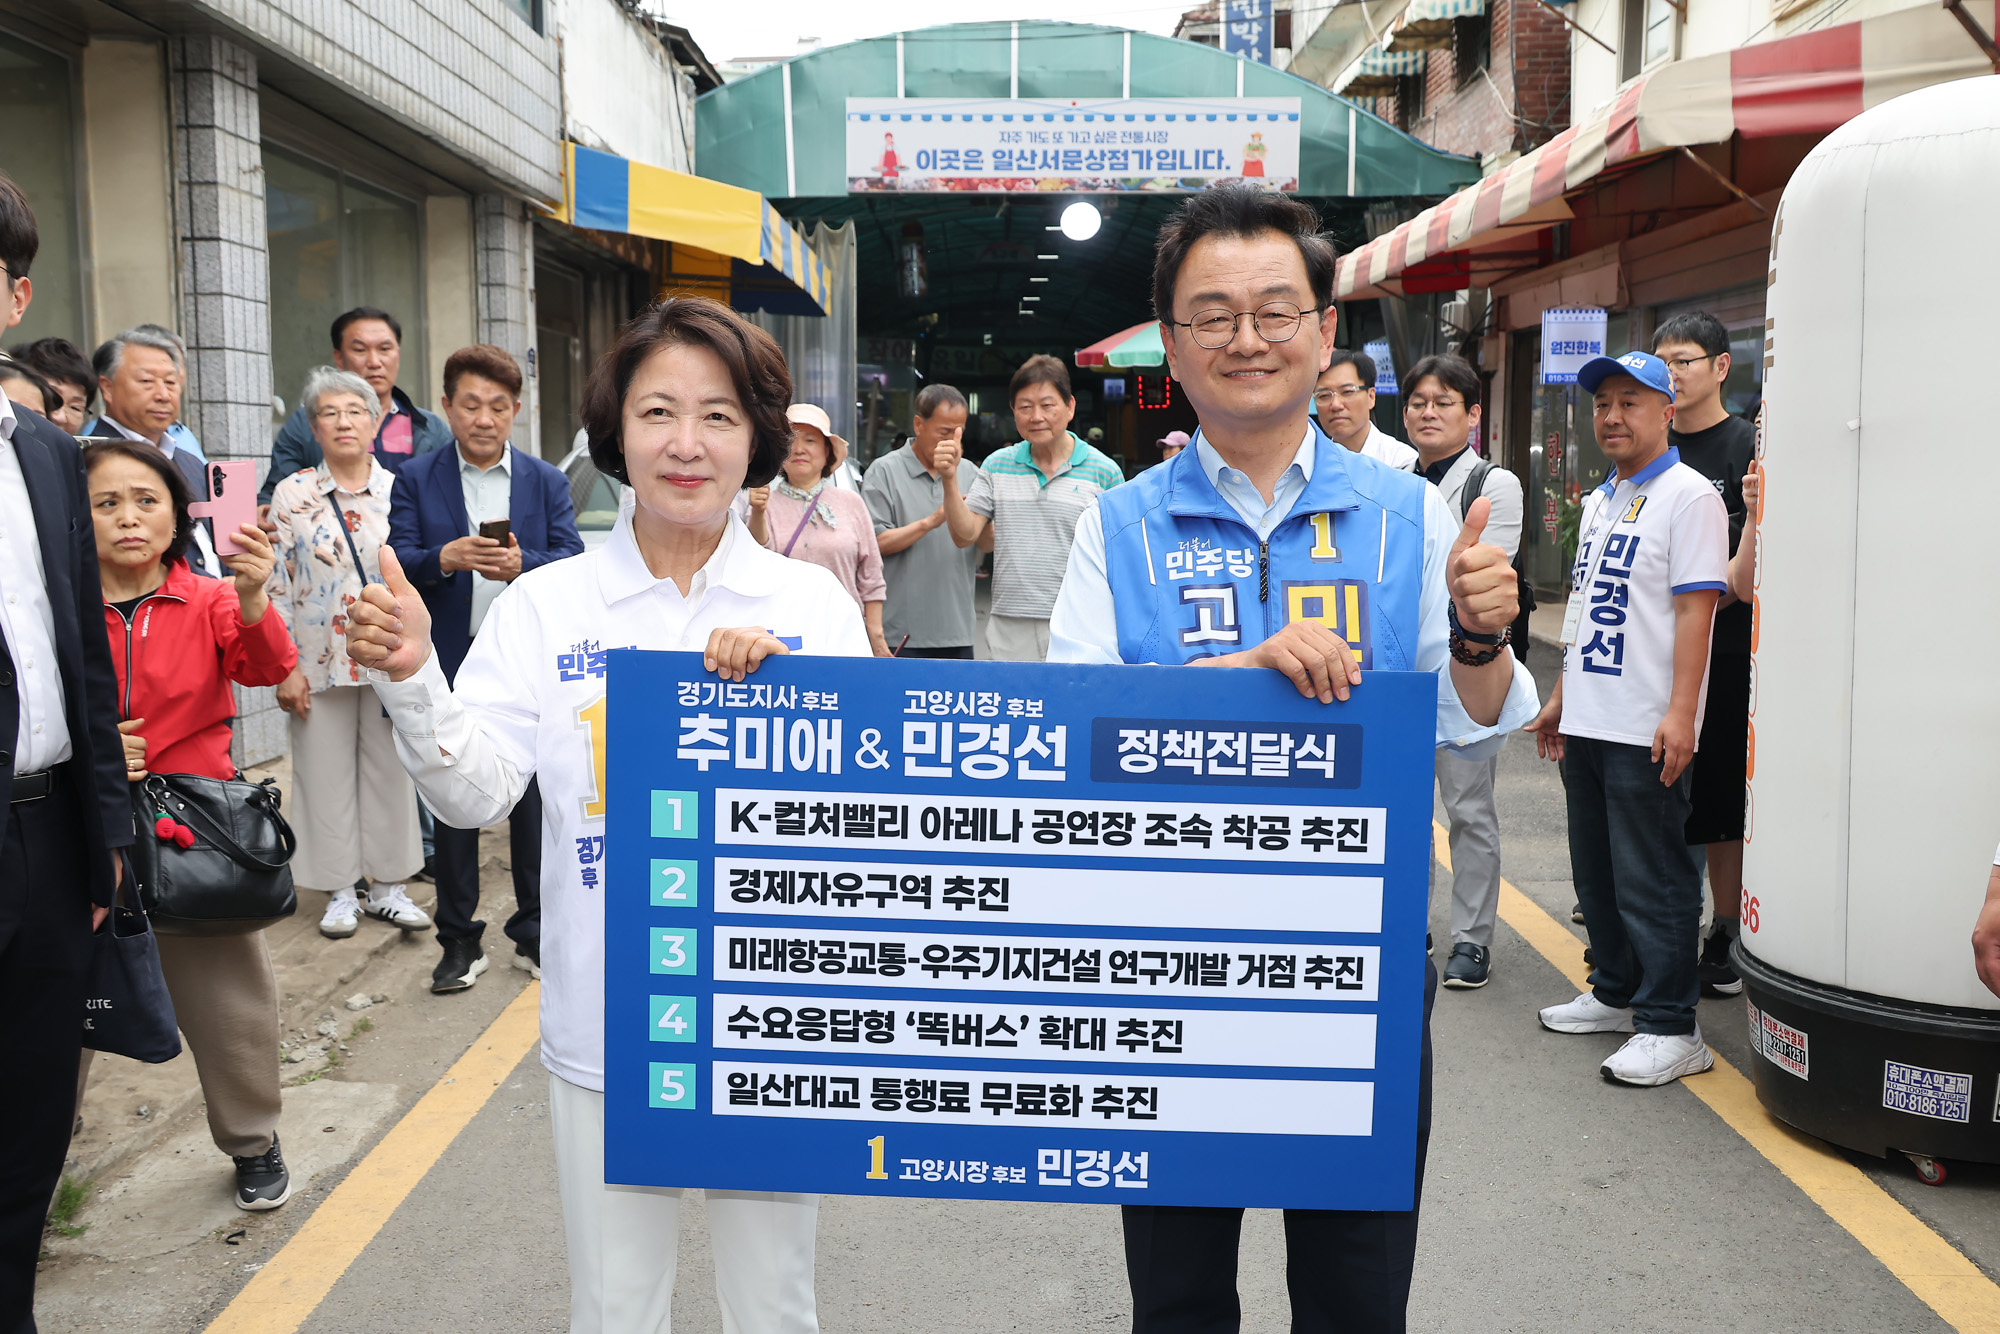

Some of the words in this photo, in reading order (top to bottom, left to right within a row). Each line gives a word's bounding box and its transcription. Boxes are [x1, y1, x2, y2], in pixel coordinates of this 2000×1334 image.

[915, 149, 984, 171] 이곳은
[991, 149, 1231, 172] 일산서문상점가입니다.
[999, 131, 1022, 144] 자주
[1025, 131, 1050, 144] 가도
[1052, 131, 1065, 144] 또
[1067, 131, 1091, 144] 가고
[1093, 131, 1117, 144] 싶은
[1622, 495, 1647, 523] 1
[1177, 536, 1211, 552] 더불어
[1309, 512, 1340, 562] 1
[1165, 547, 1255, 581] 민주당
[1580, 533, 1640, 677] 민경선
[570, 639, 600, 655] 더불어
[676, 681, 798, 710] 경기도지사
[801, 690, 839, 711] 후보
[903, 689, 1001, 717] 고양시장
[1006, 699, 1044, 718] 후보
[676, 712, 843, 775] 추미애
[854, 727, 891, 770] &
[902, 720, 1067, 782] 민경선
[1117, 728, 1337, 780] 정책전달식
[667, 798, 683, 831] 1
[730, 800, 908, 840] K-컬처밸리
[920, 805, 1023, 843] 아레나
[1031, 809, 1136, 847] 공연장
[1144, 813, 1213, 850] 조속
[1222, 814, 1291, 852] 착공
[1300, 817, 1369, 853] 추진
[661, 866, 688, 900] 2
[729, 868, 932, 910] 경제자유구역
[942, 875, 1010, 912] 추진
[1740, 886, 1760, 934] 36
[660, 935, 687, 968] 3
[729, 937, 1101, 984] 미래항공교통-우주기지건설
[1108, 949, 1231, 987] 연구개발
[1237, 954, 1296, 989] 거점
[1303, 955, 1364, 990] 추진
[657, 1003, 688, 1035] 4
[727, 1005, 896, 1044] 수요응답형
[1039, 1015, 1107, 1052] 확대
[1116, 1018, 1183, 1054] 추진
[1763, 1015, 1805, 1049] 휴대폰소액결제
[659, 1069, 686, 1102] 5
[727, 1072, 860, 1109] 일산대교
[870, 1077, 971, 1113] 통행료
[980, 1082, 1083, 1118] 무료화
[1091, 1085, 1158, 1120] 추진
[1888, 1064, 1969, 1094] 휴대폰소액결제
[865, 1135, 889, 1180] 1
[898, 1158, 989, 1184] 고양시장
[991, 1166, 1027, 1184] 후보
[1037, 1149, 1149, 1189] 민경선
